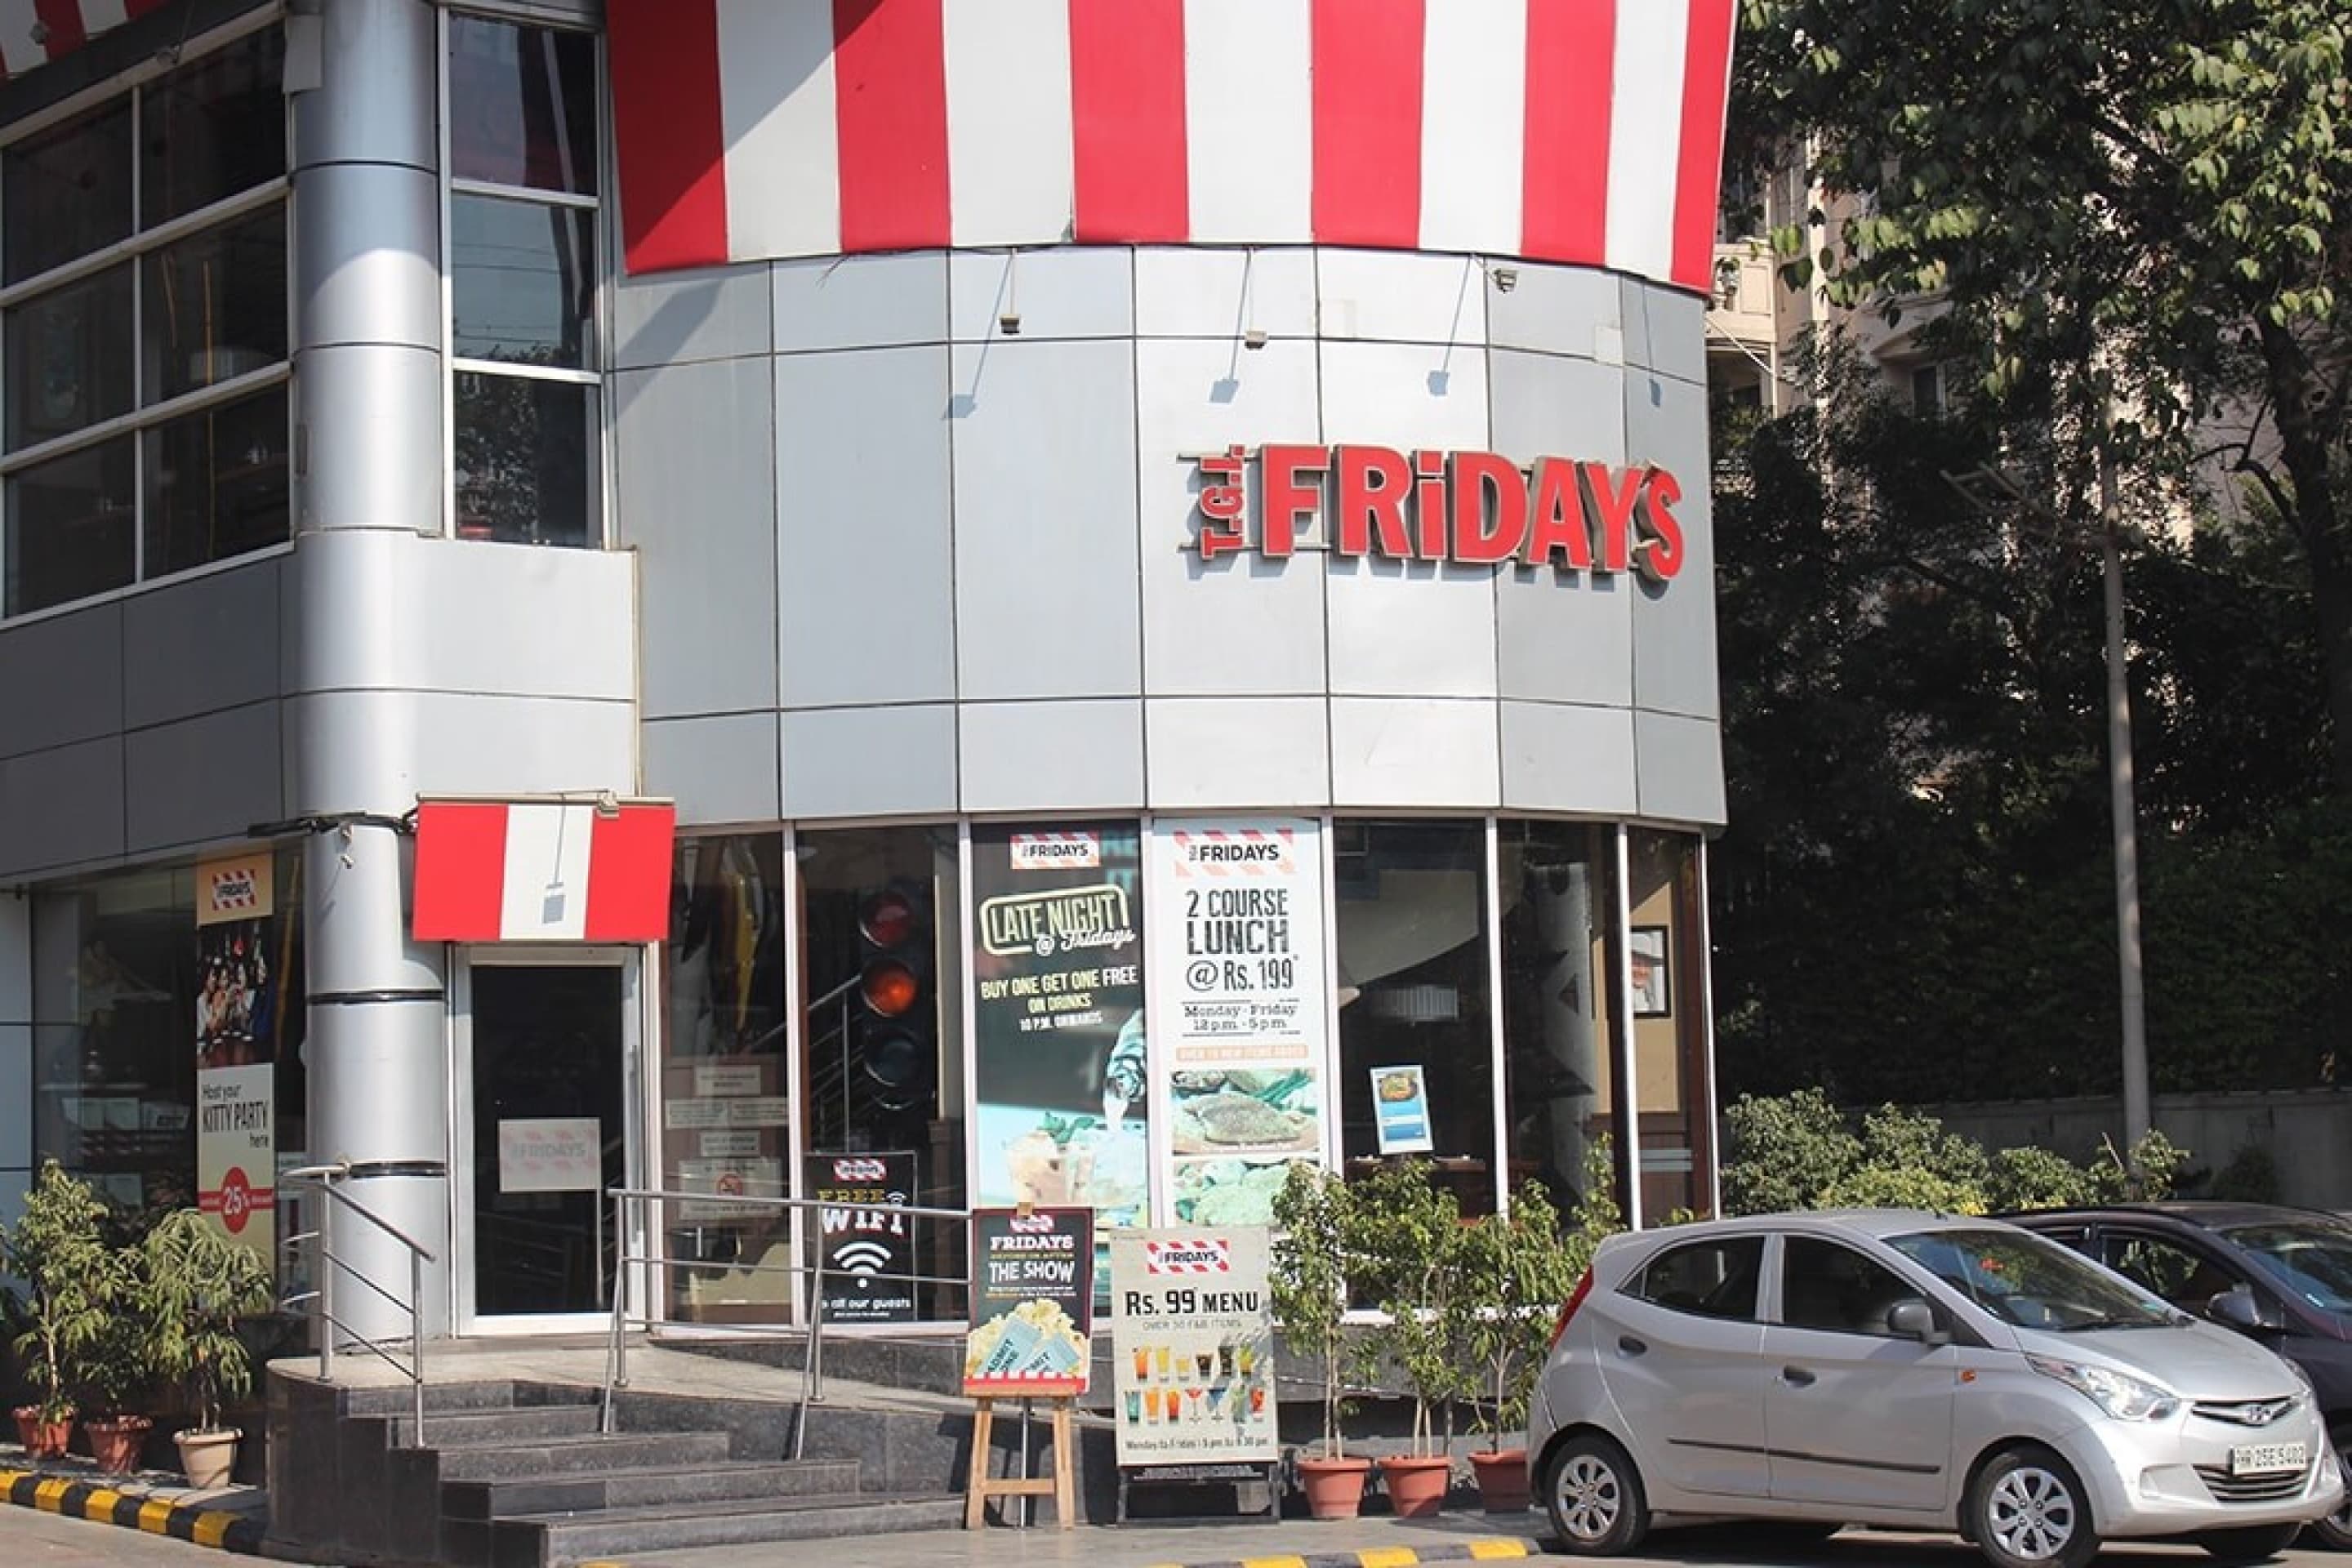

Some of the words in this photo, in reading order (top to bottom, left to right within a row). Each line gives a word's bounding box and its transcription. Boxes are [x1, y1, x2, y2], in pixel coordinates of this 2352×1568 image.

[1199, 844, 1281, 861] FRIDAYS
[1186, 889, 1200, 917] 2
[1208, 888, 1289, 917] COURSE
[990, 902, 1043, 943] LATE
[1047, 894, 1116, 938] NIGHT
[1187, 919, 1290, 954] LUNCH
[981, 979, 1009, 1000] BUY
[1012, 976, 1040, 996] ONE
[1041, 973, 1068, 992] GET
[1071, 969, 1099, 988] ONE
[1102, 964, 1138, 987] FREE
[1186, 960, 1219, 991] @
[1223, 960, 1254, 991] Rs.
[1027, 998, 1046, 1013] ON
[1048, 992, 1092, 1011] DRINKS
[1184, 1004, 1241, 1018] Monday
[1250, 1003, 1298, 1017] Friday
[203, 1103, 233, 1133] KITTY
[234, 1100, 269, 1131] PARTY
[817, 1189, 885, 1203] FREE
[990, 1234, 1075, 1250] FRIDAYS
[1164, 1250, 1219, 1264] FRIDAYS
[987, 1260, 1021, 1283] THE
[1022, 1260, 1075, 1283] SHOW
[1125, 1290, 1160, 1316] Rs.
[1165, 1289, 1196, 1314] 99
[1202, 1292, 1259, 1313] MENU
